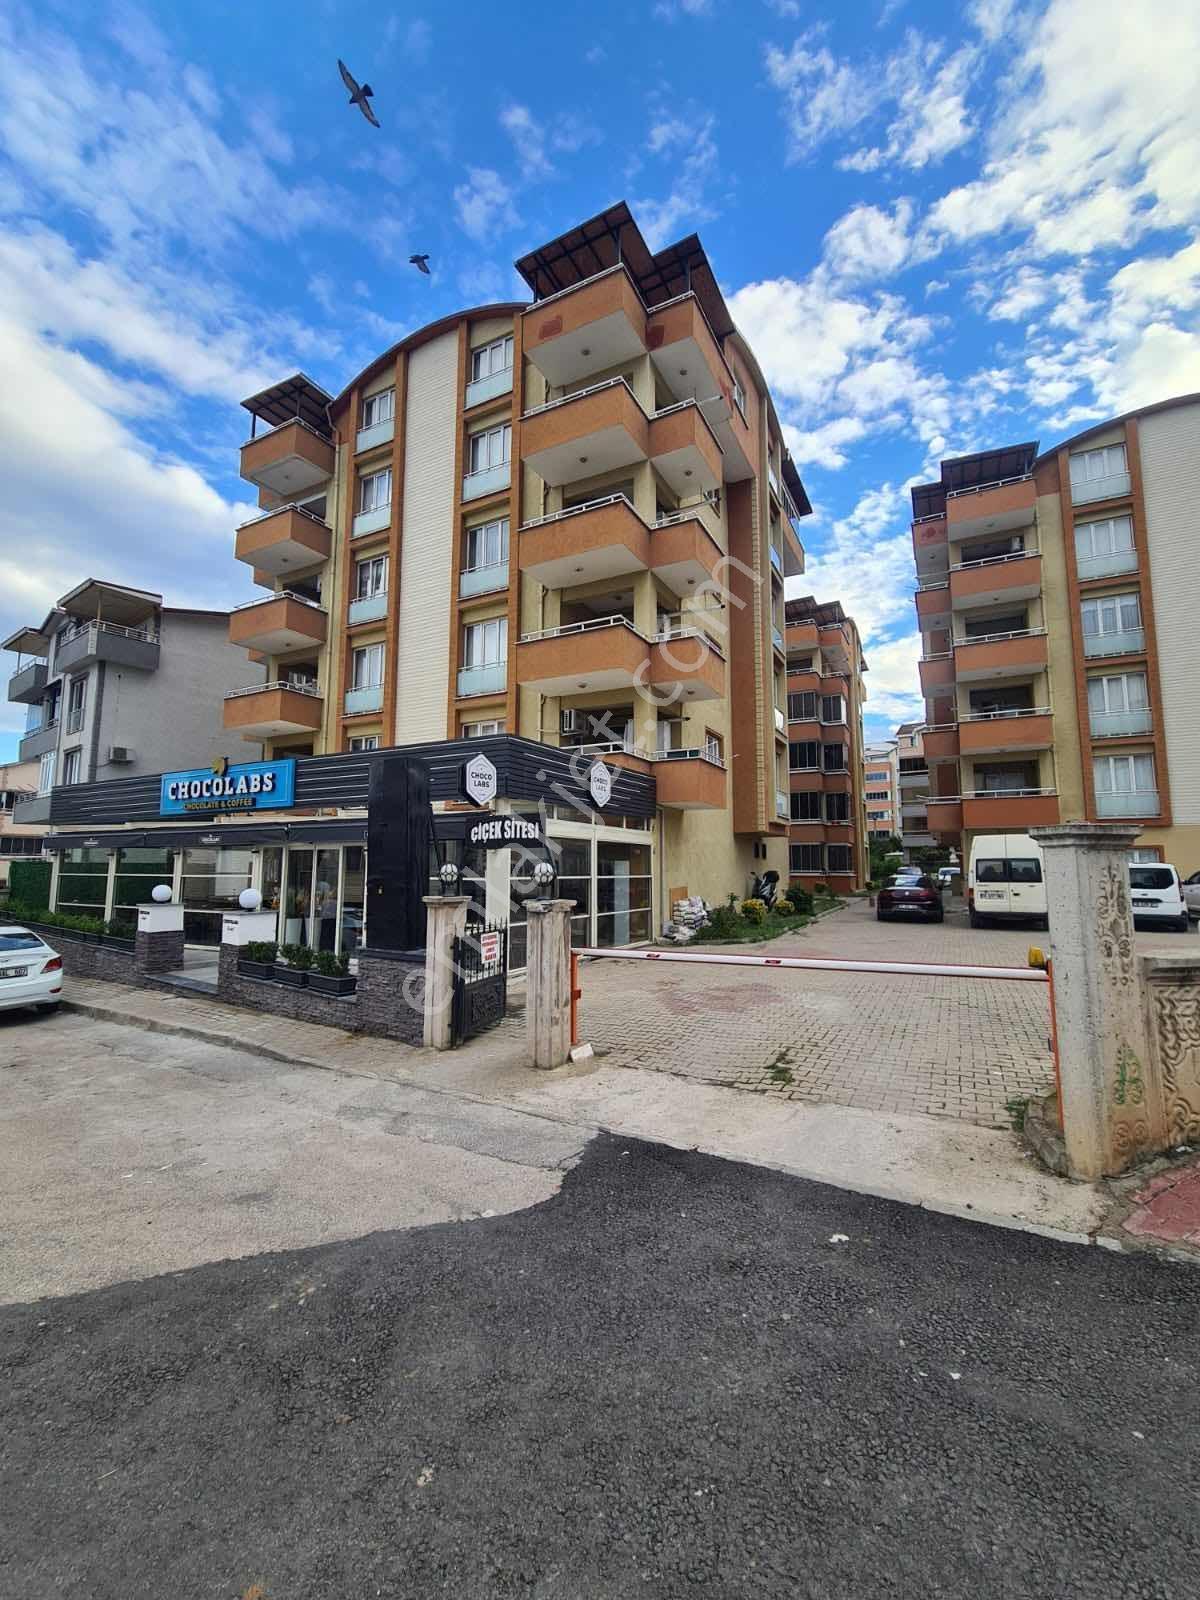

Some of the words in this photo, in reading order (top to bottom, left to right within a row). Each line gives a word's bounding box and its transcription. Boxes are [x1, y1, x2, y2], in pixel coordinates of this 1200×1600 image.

[471, 772, 493, 782] CHOCO
[169, 772, 273, 799] CHOCOLABS
[473, 780, 490, 788] LABS
[184, 800, 220, 811] CHOCOLATE
[227, 798, 252, 807] COFFEE
